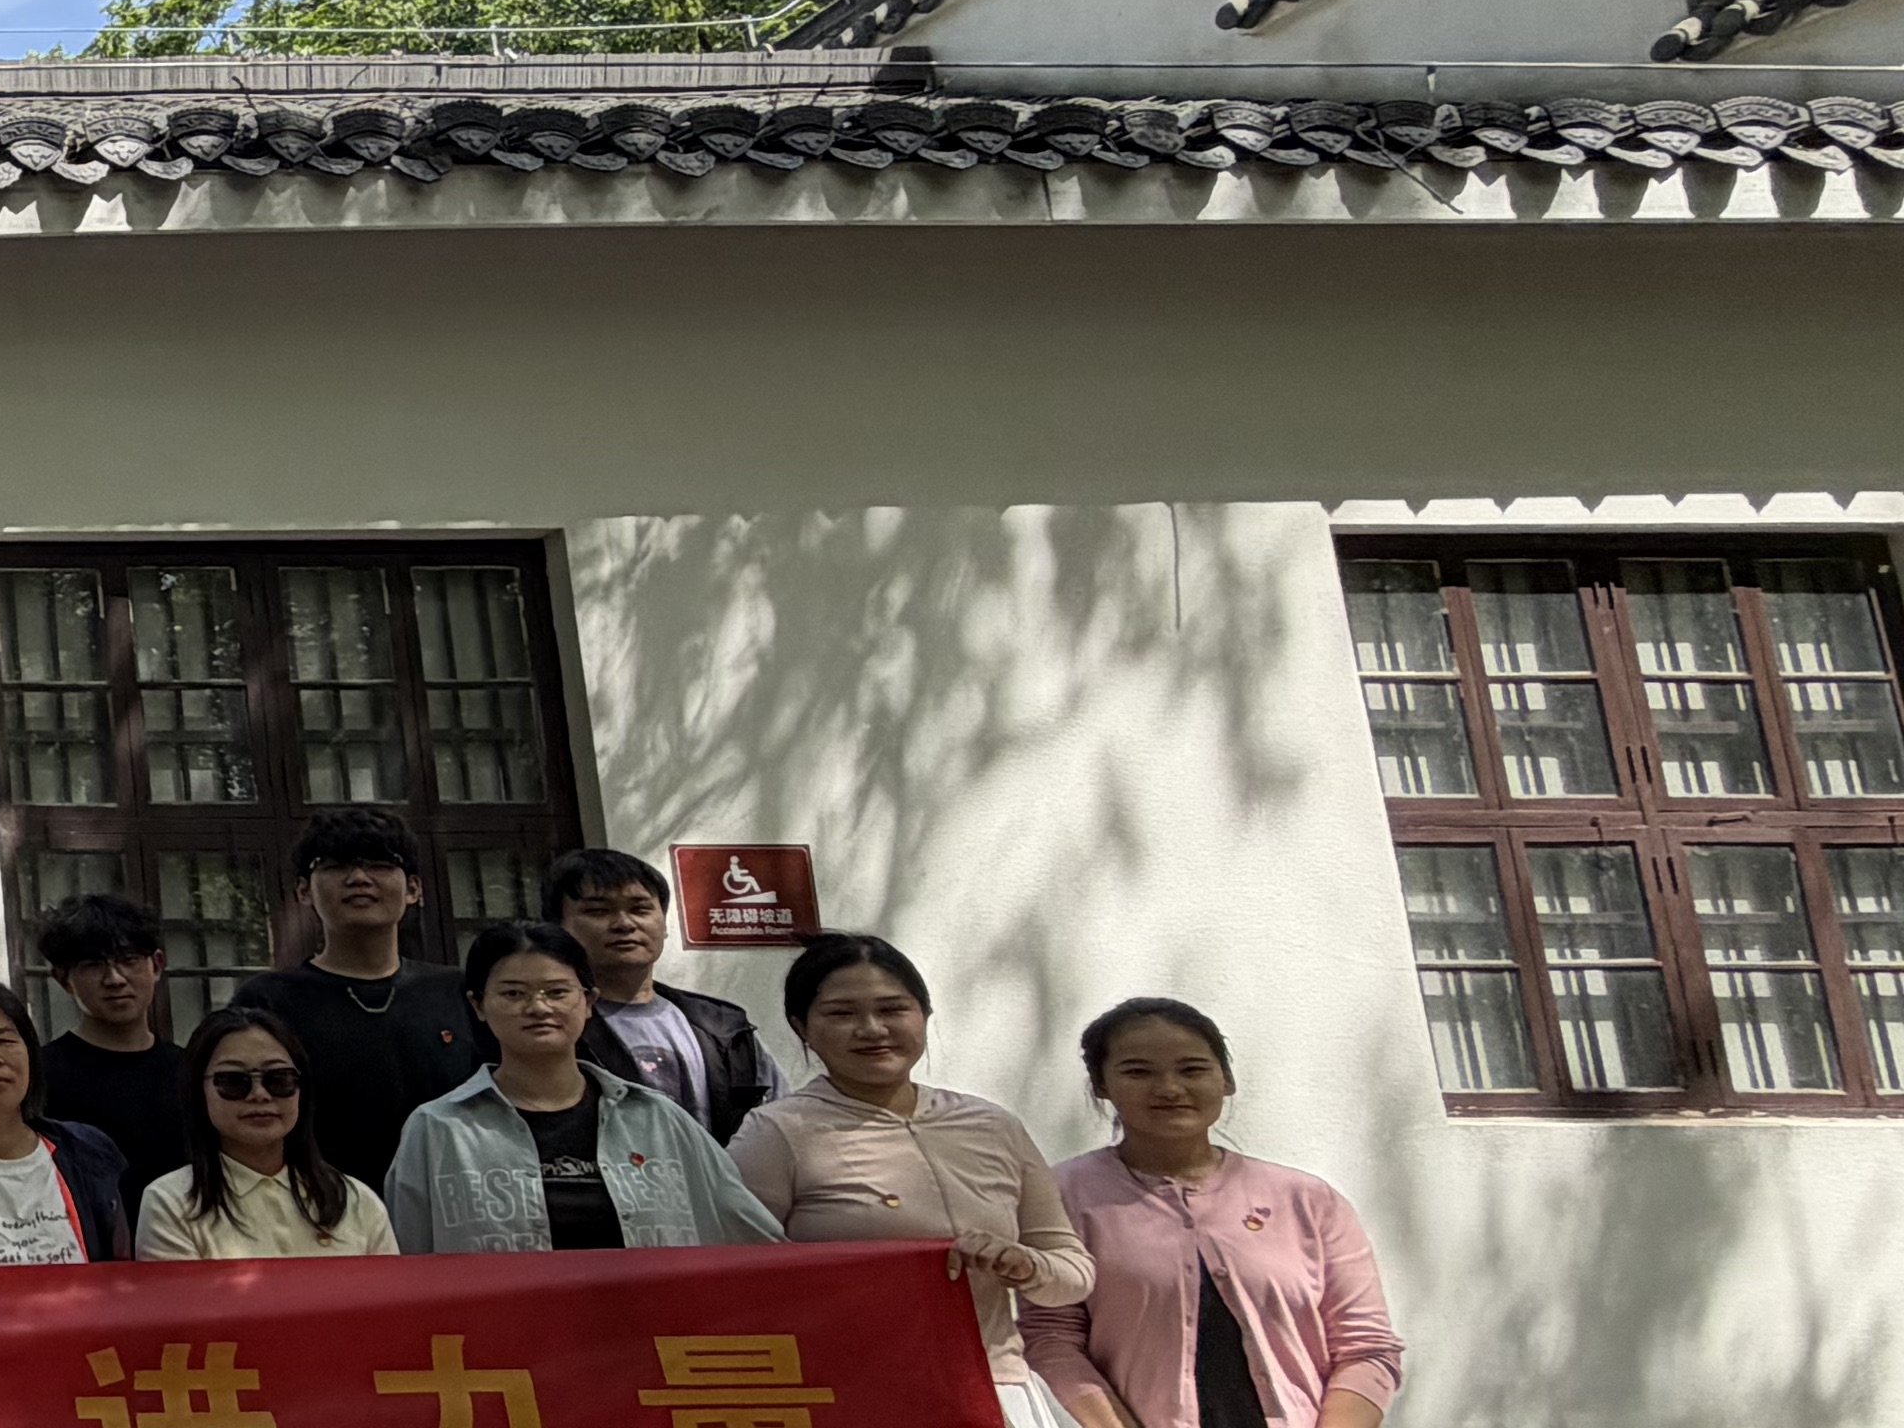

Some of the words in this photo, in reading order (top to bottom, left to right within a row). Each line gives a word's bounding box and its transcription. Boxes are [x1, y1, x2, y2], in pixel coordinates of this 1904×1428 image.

[709, 908, 793, 924] 无障碍坡道
[711, 925, 764, 935] Accessible
[2, 1210, 69, 1229] everythin
